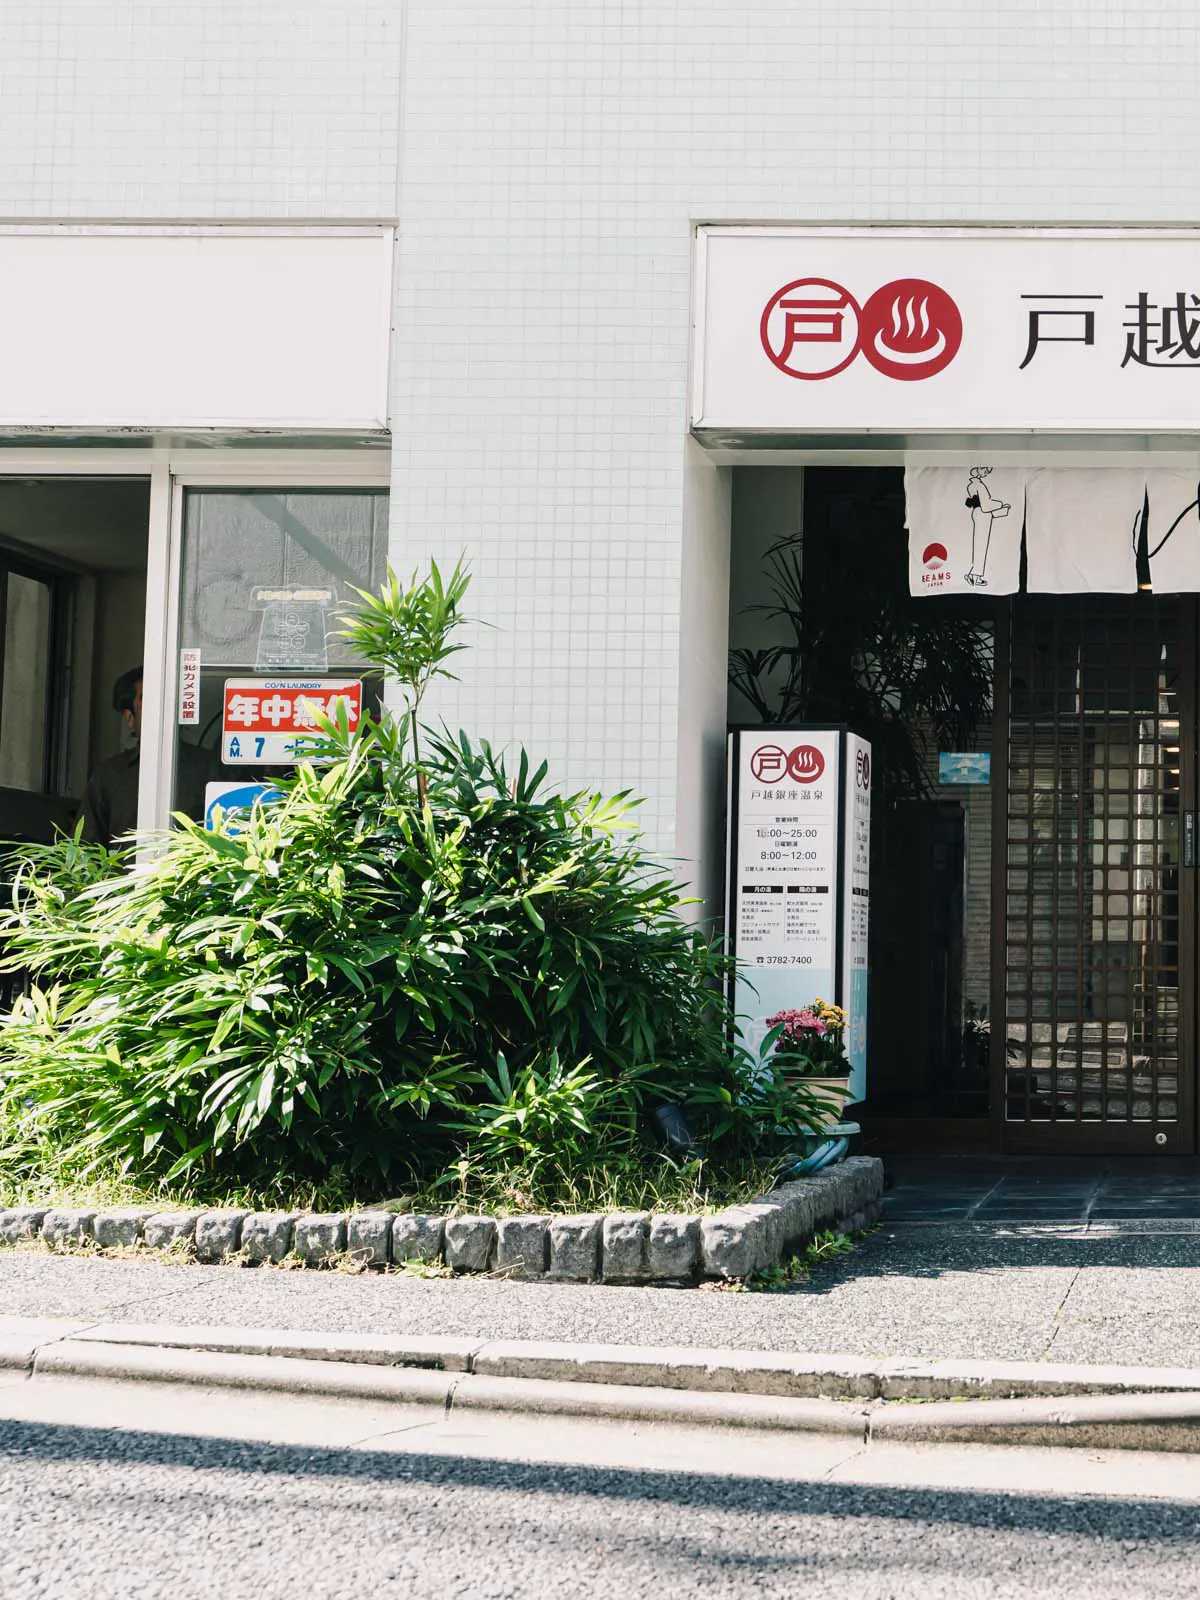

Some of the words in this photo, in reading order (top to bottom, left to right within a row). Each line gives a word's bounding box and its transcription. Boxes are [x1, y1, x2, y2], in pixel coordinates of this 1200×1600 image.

[183, 653, 197, 719] 防犯カメラ設置
[254, 737, 266, 758] 7
[751, 789, 824, 801] 戸越銀座温泉
[766, 956, 812, 964] 3782-7400
